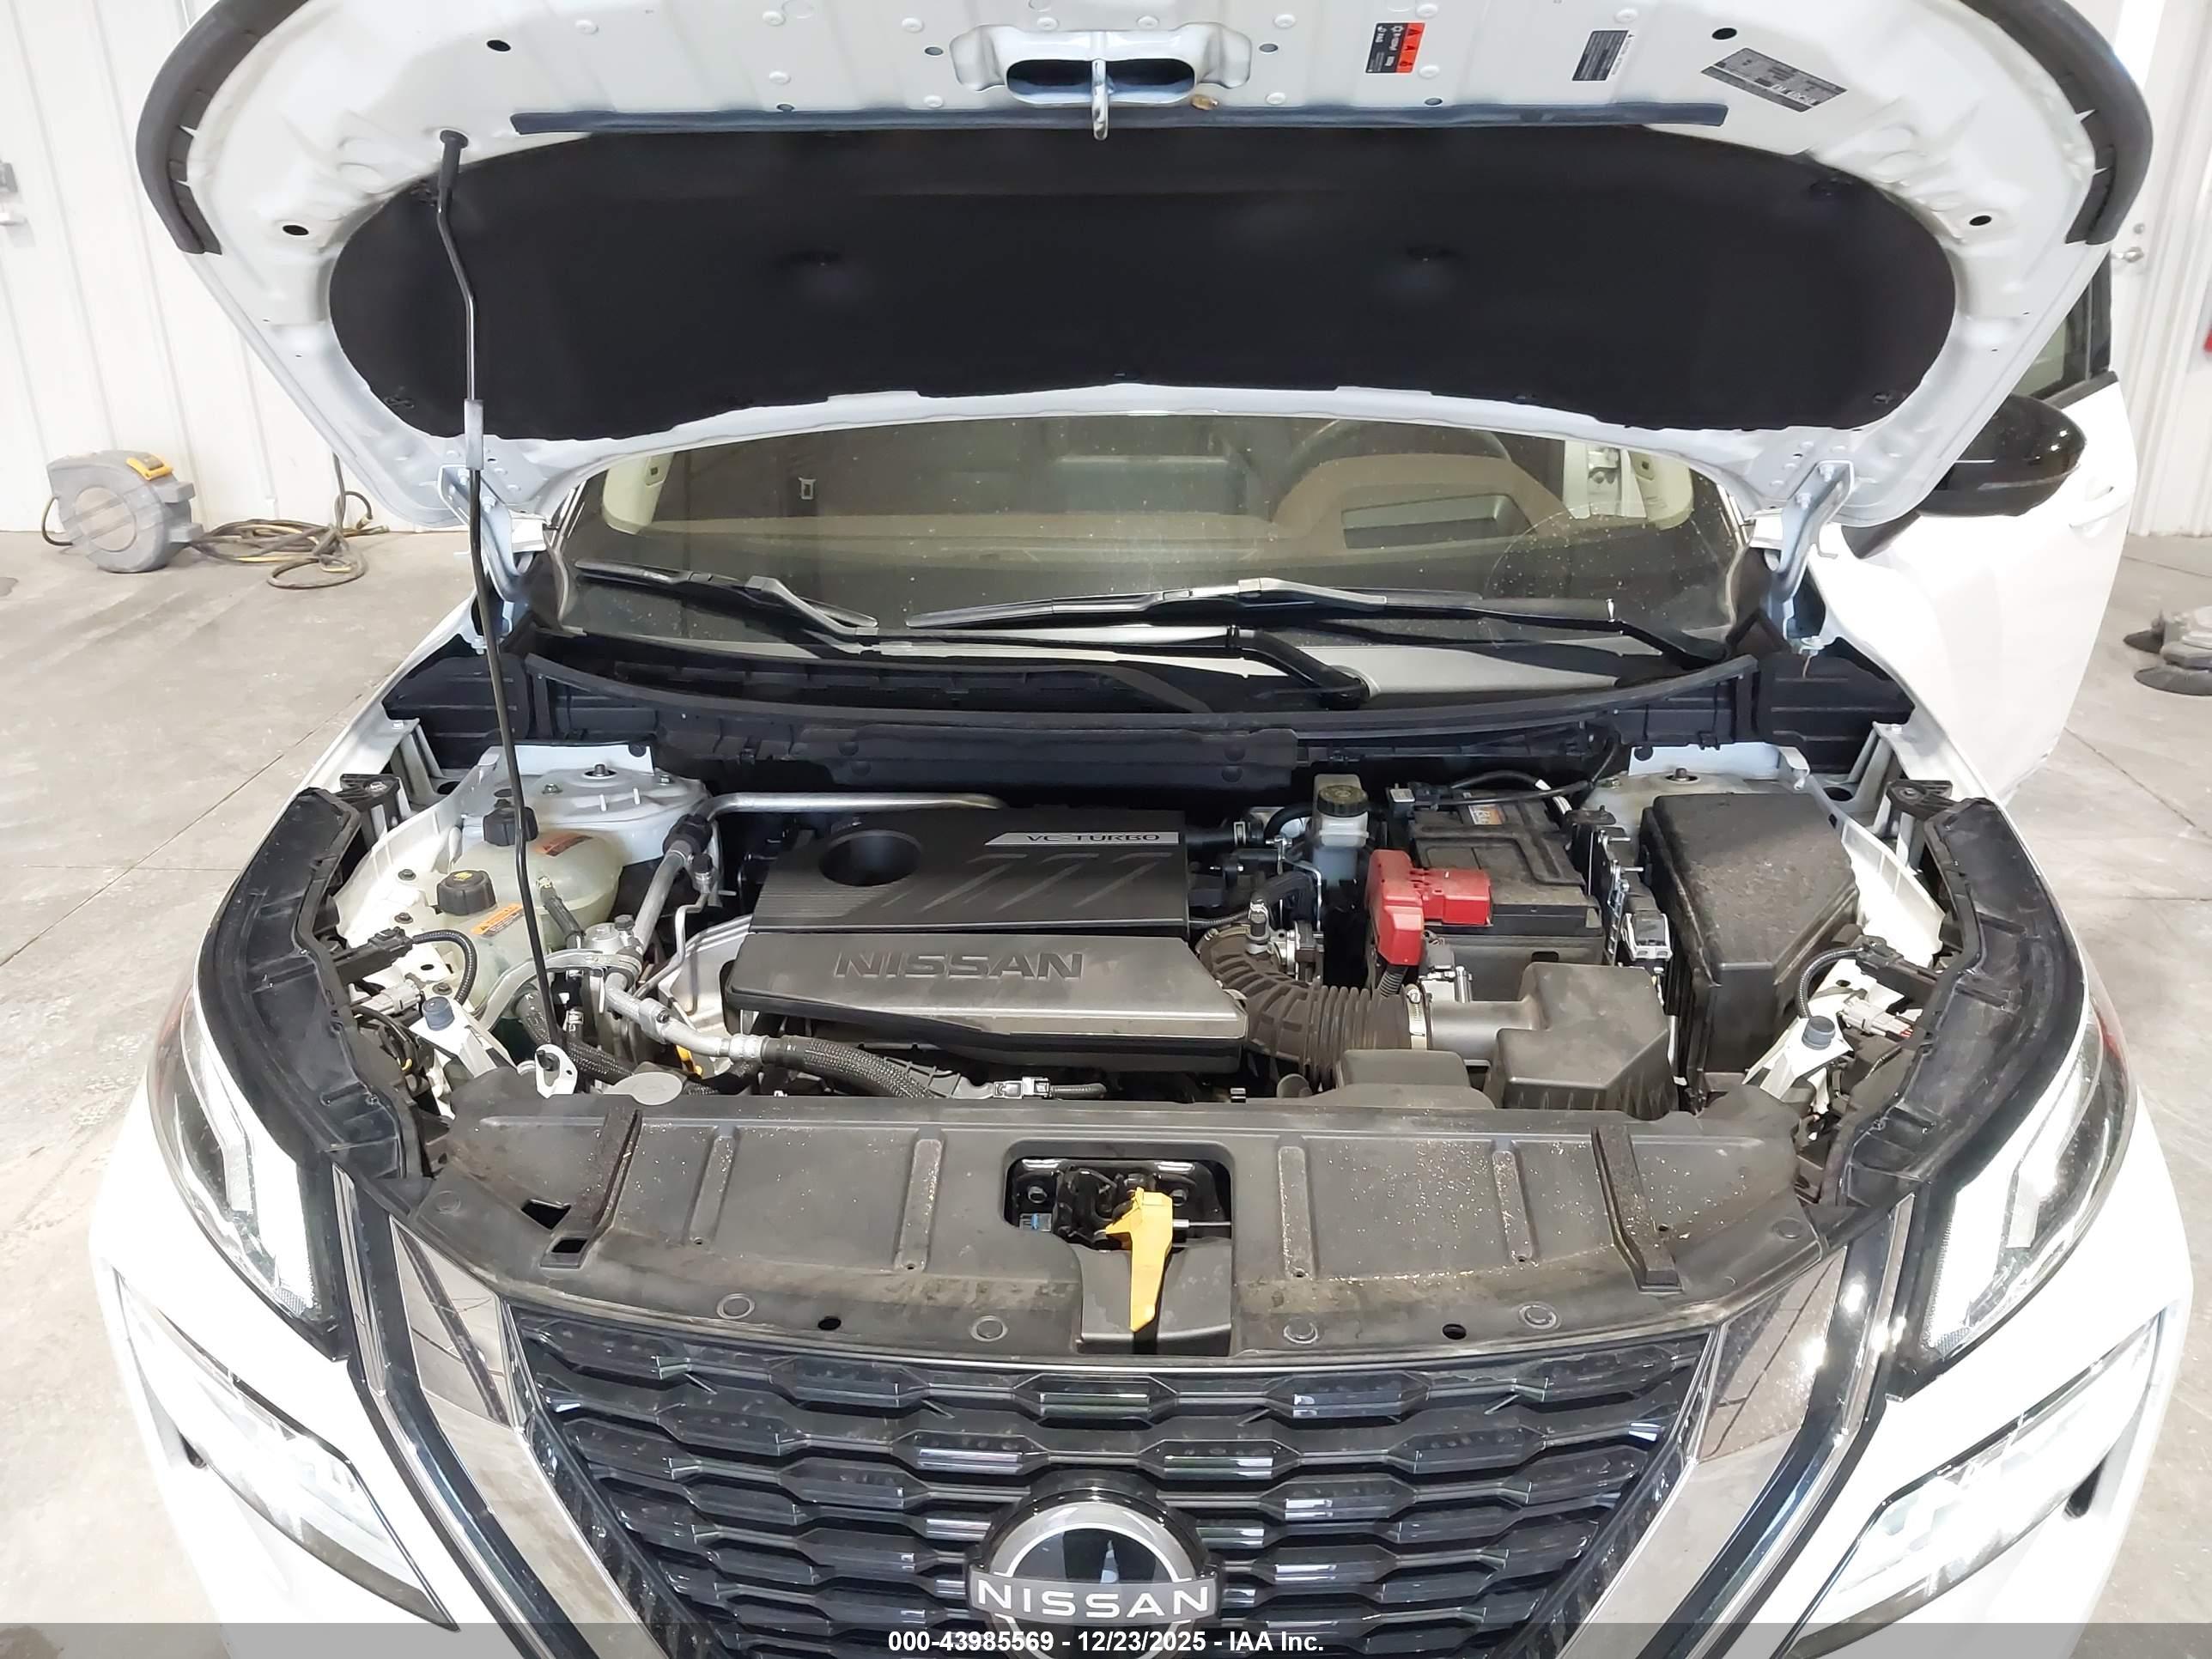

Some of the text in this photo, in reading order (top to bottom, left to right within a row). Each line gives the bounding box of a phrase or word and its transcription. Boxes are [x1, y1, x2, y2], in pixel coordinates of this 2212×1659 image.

[1025, 834, 1160, 842] VC-TURBO
[833, 951, 1085, 981] NISSAN
[977, 1578, 1208, 1619] NISSAN
